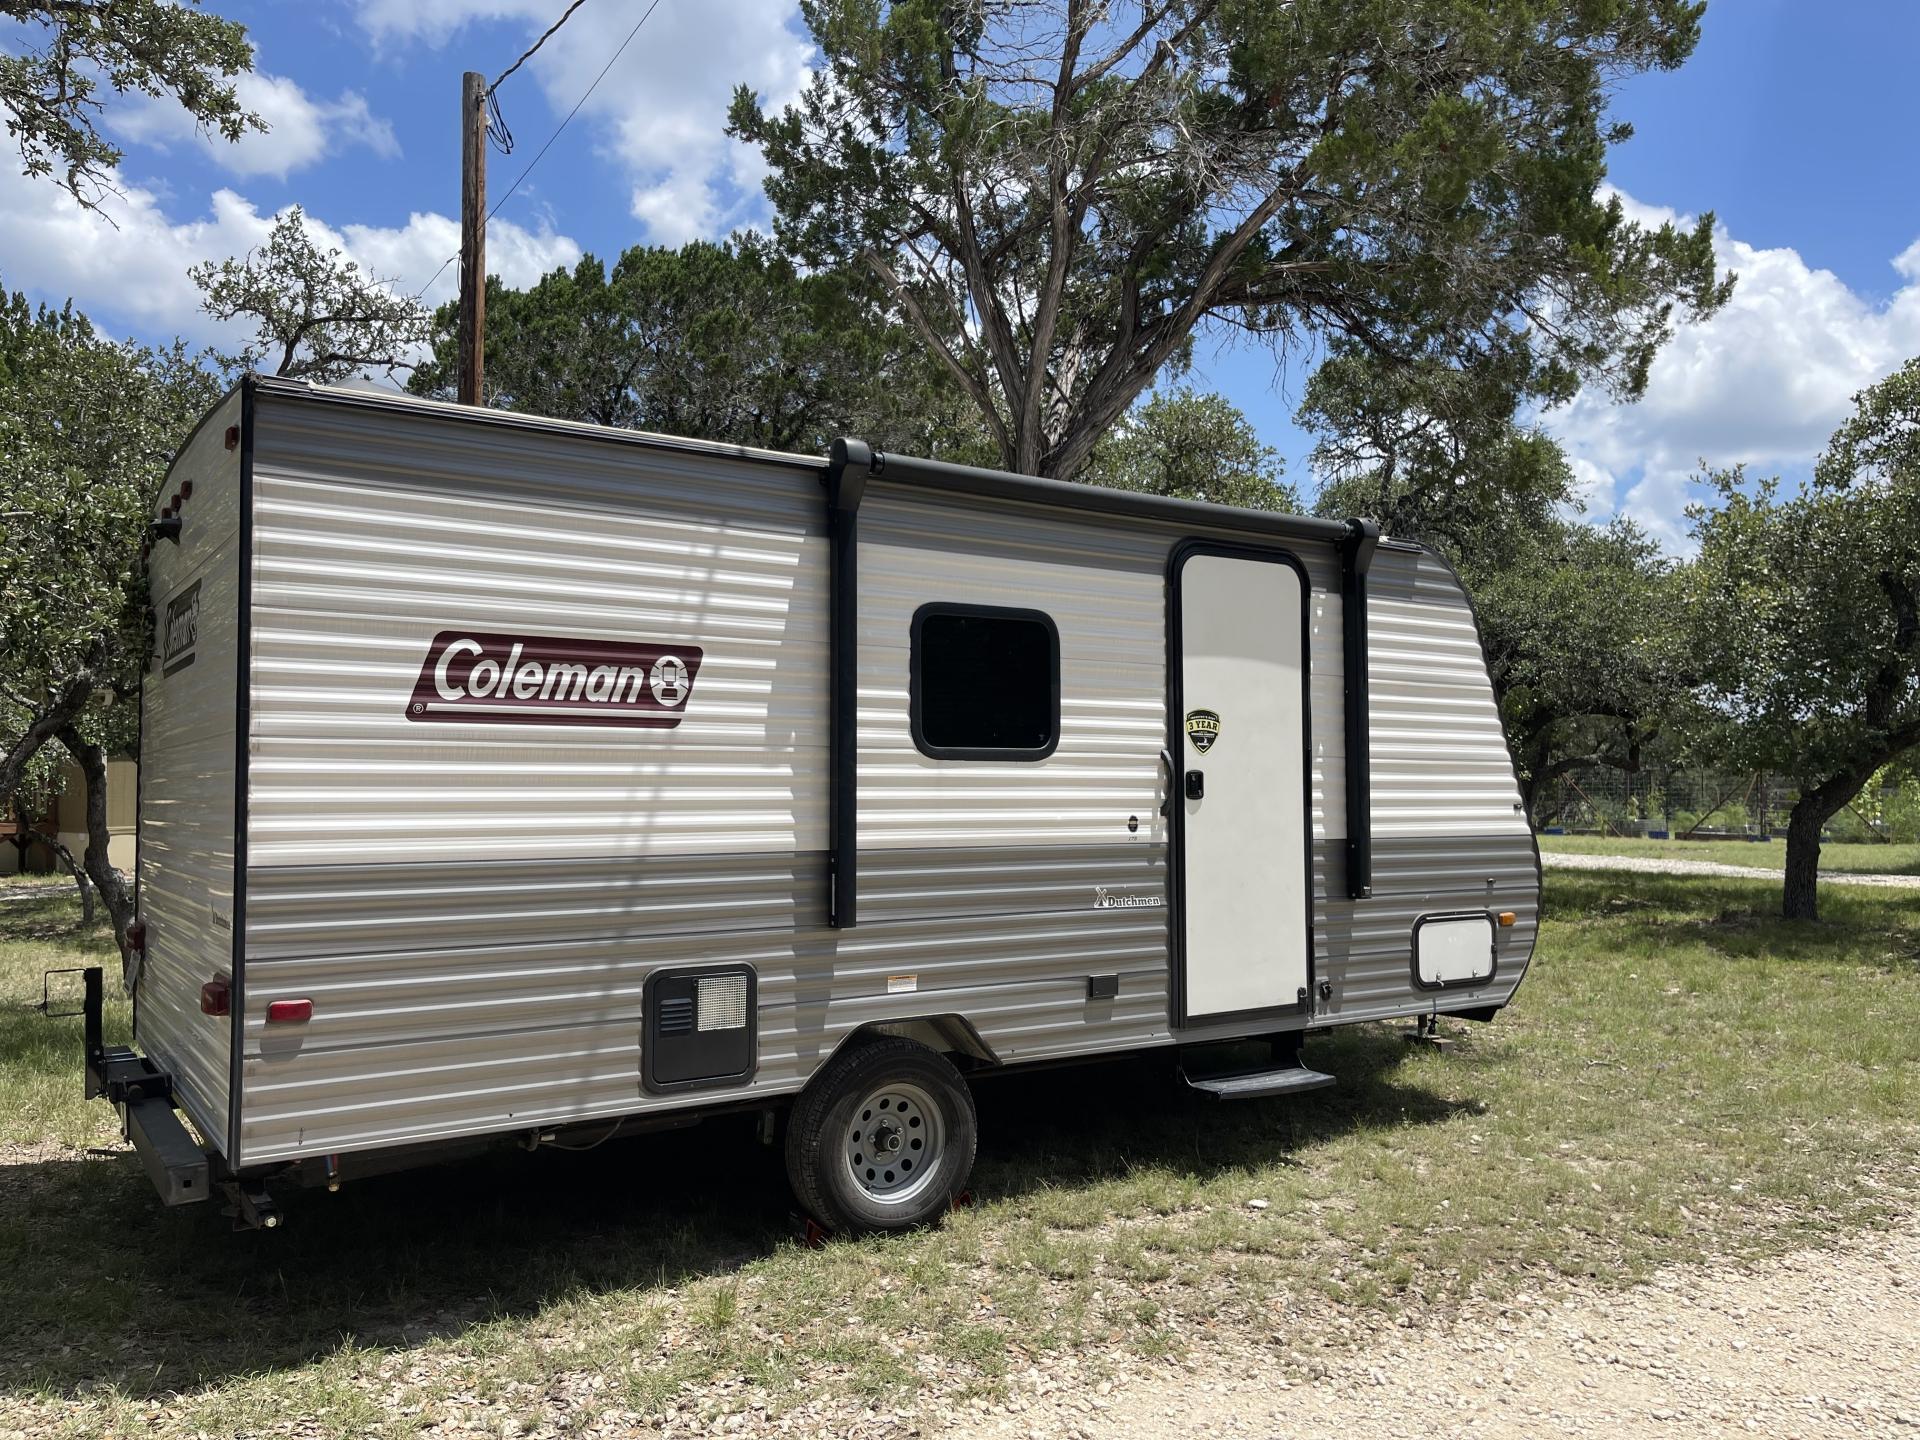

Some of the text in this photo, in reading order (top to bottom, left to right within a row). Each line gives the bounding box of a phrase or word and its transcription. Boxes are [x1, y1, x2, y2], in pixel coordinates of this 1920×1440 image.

[434, 638, 645, 704] Coleman
[1188, 720, 1218, 731] 3 YEAR
[1106, 895, 1160, 908] Dutchmen
